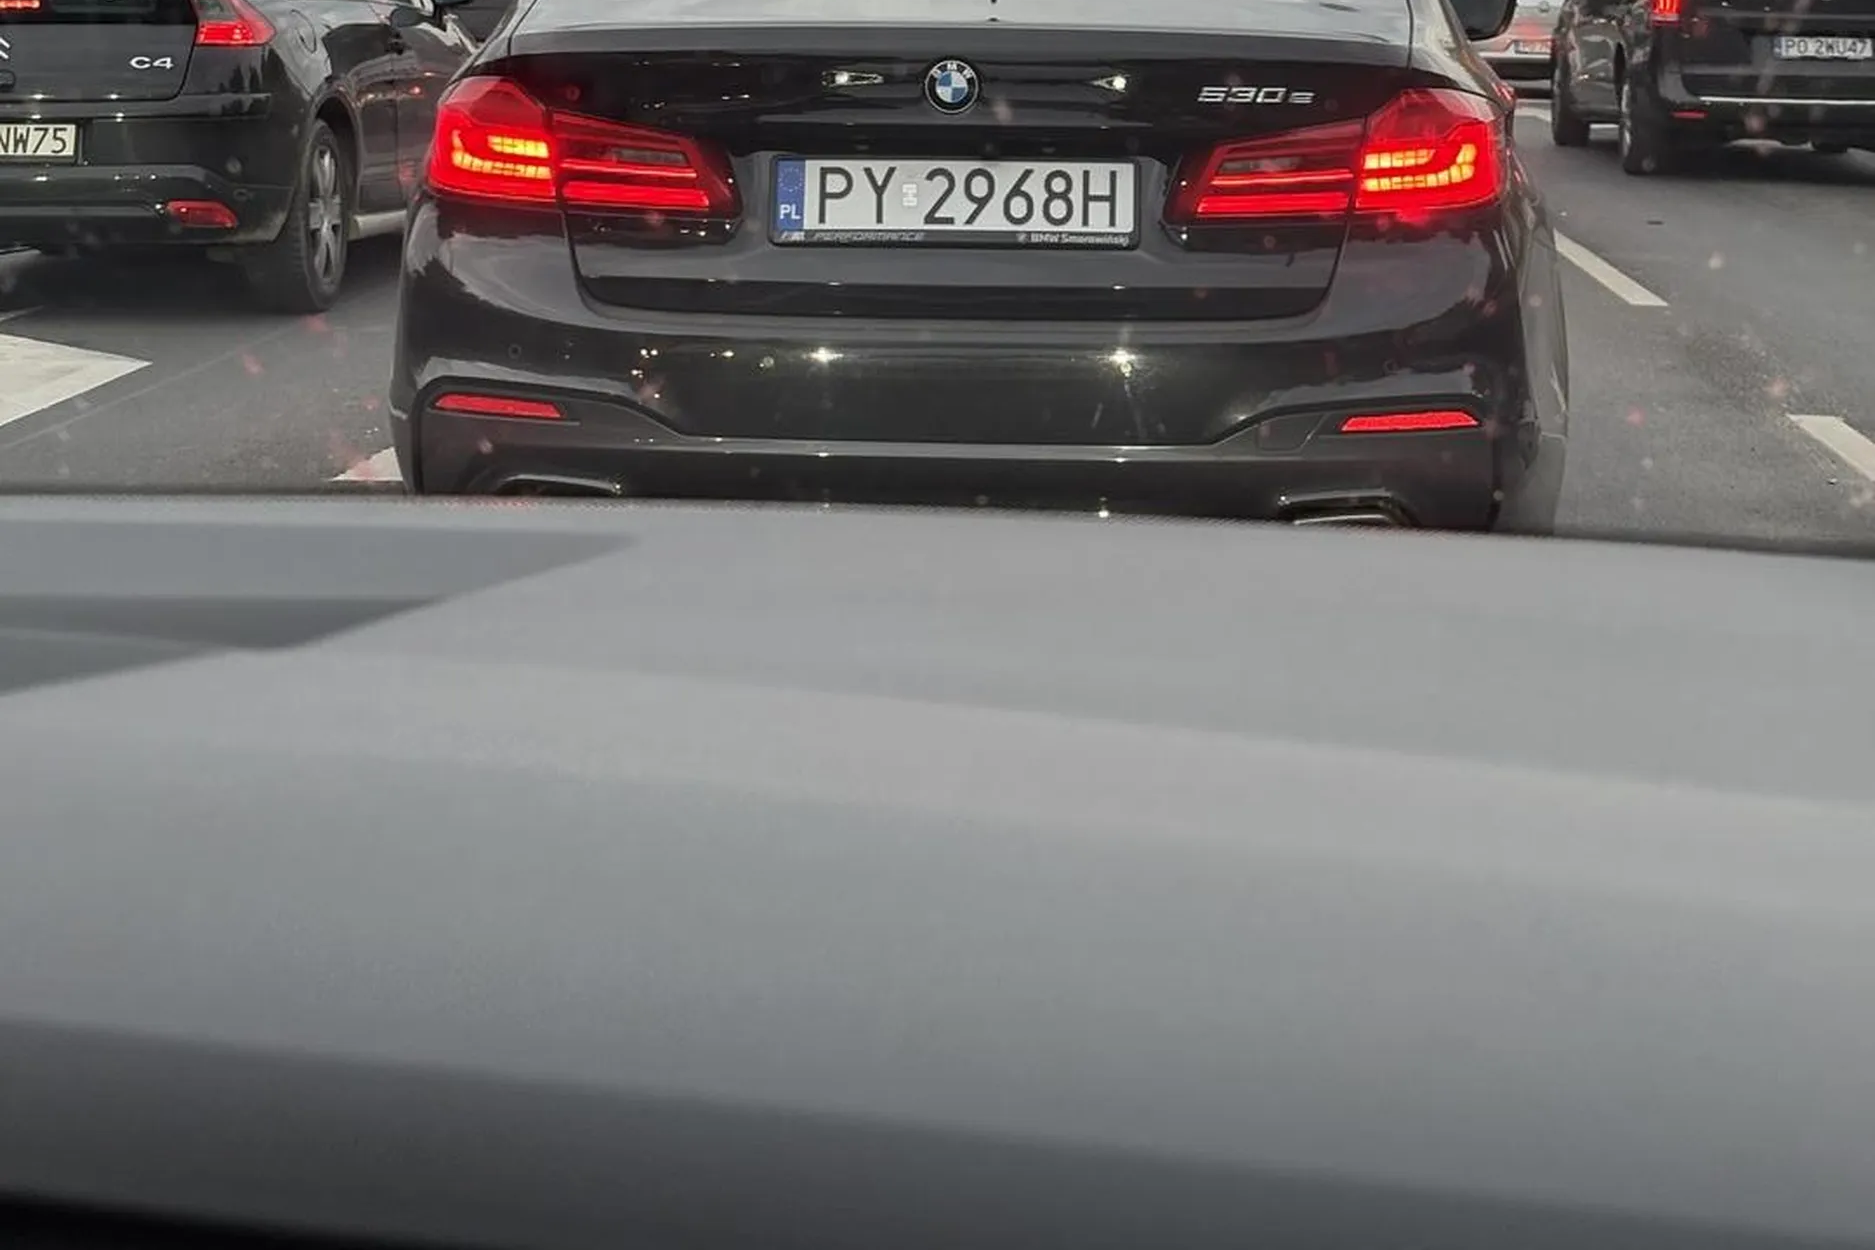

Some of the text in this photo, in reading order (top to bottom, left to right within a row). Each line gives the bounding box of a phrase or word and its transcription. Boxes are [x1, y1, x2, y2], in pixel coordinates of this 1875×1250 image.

[130, 56, 173, 69] C4
[817, 165, 1118, 227] PY 2968H
[779, 204, 801, 220] PL
[814, 232, 924, 241] PERFORMANCE
